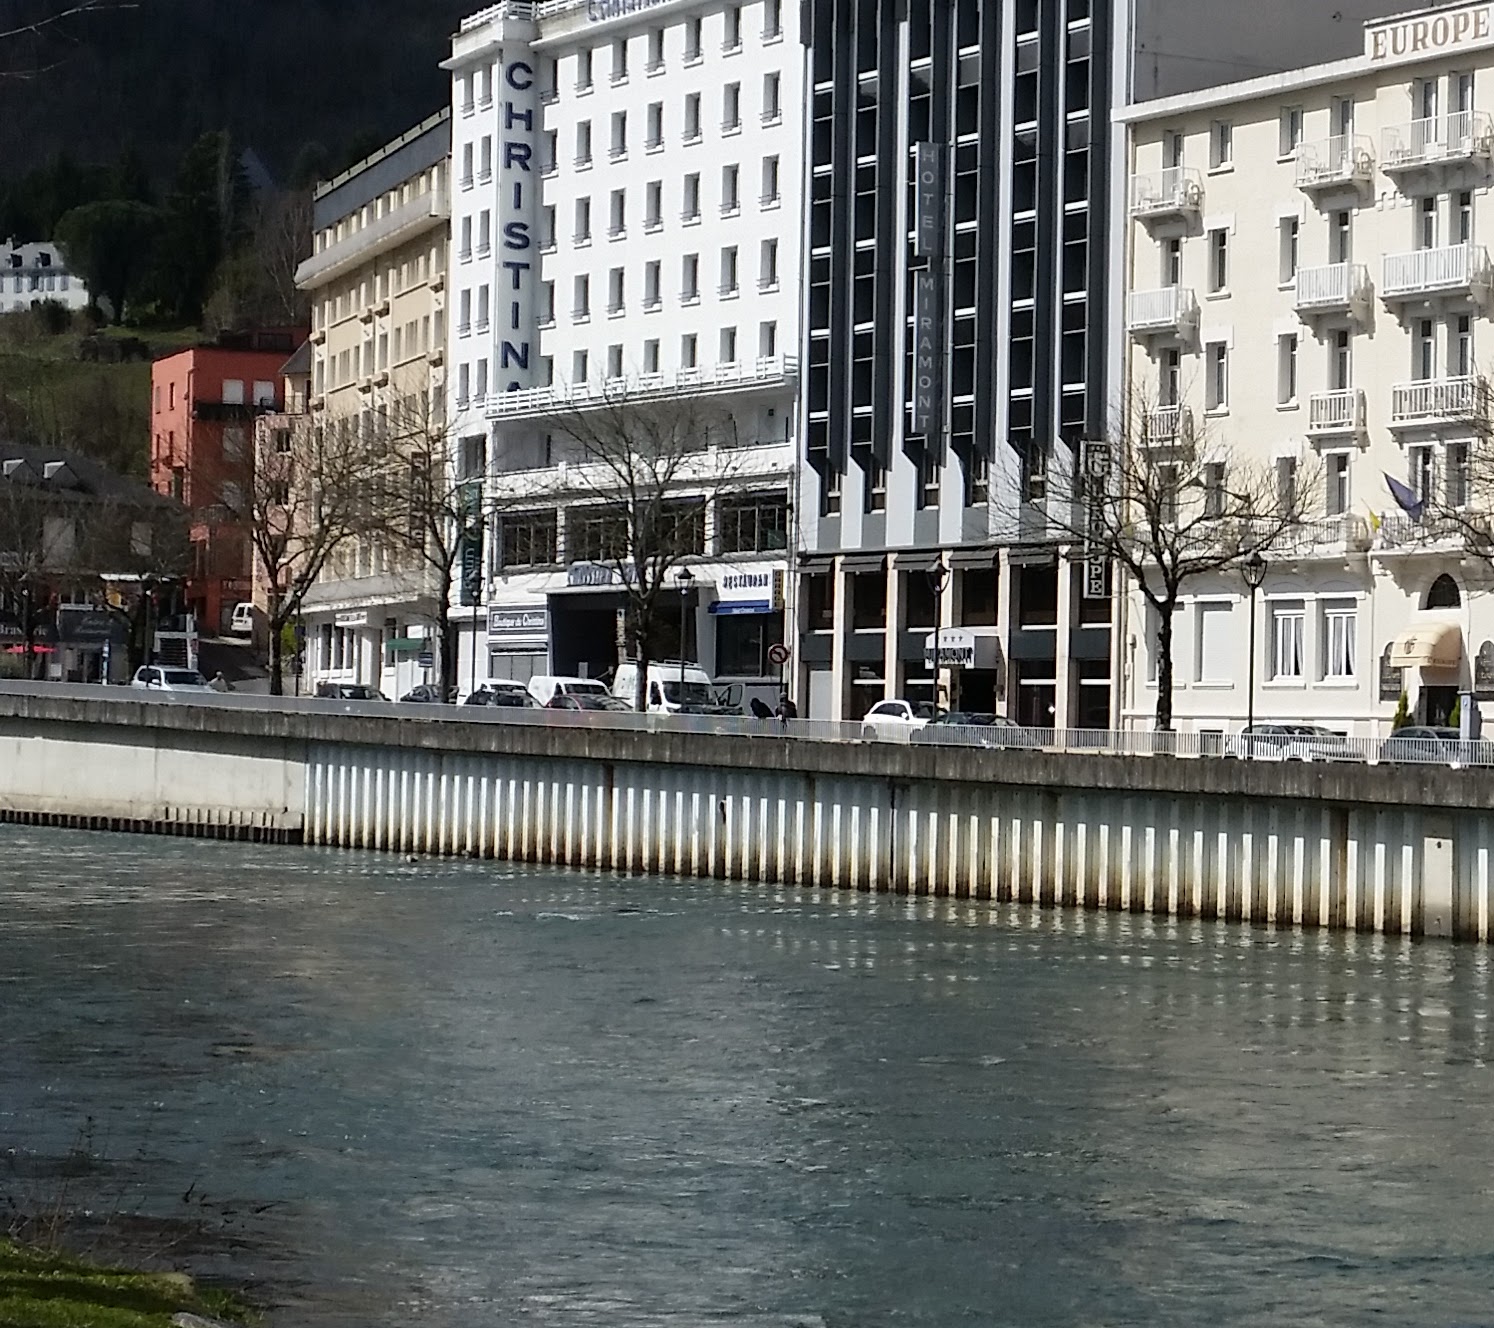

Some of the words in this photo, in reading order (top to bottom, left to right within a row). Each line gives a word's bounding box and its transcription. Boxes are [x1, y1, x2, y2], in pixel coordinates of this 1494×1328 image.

[1371, 8, 1490, 61] EUROPE
[921, 150, 935, 252] HOTEL
[918, 277, 934, 428] MIRAMONT
